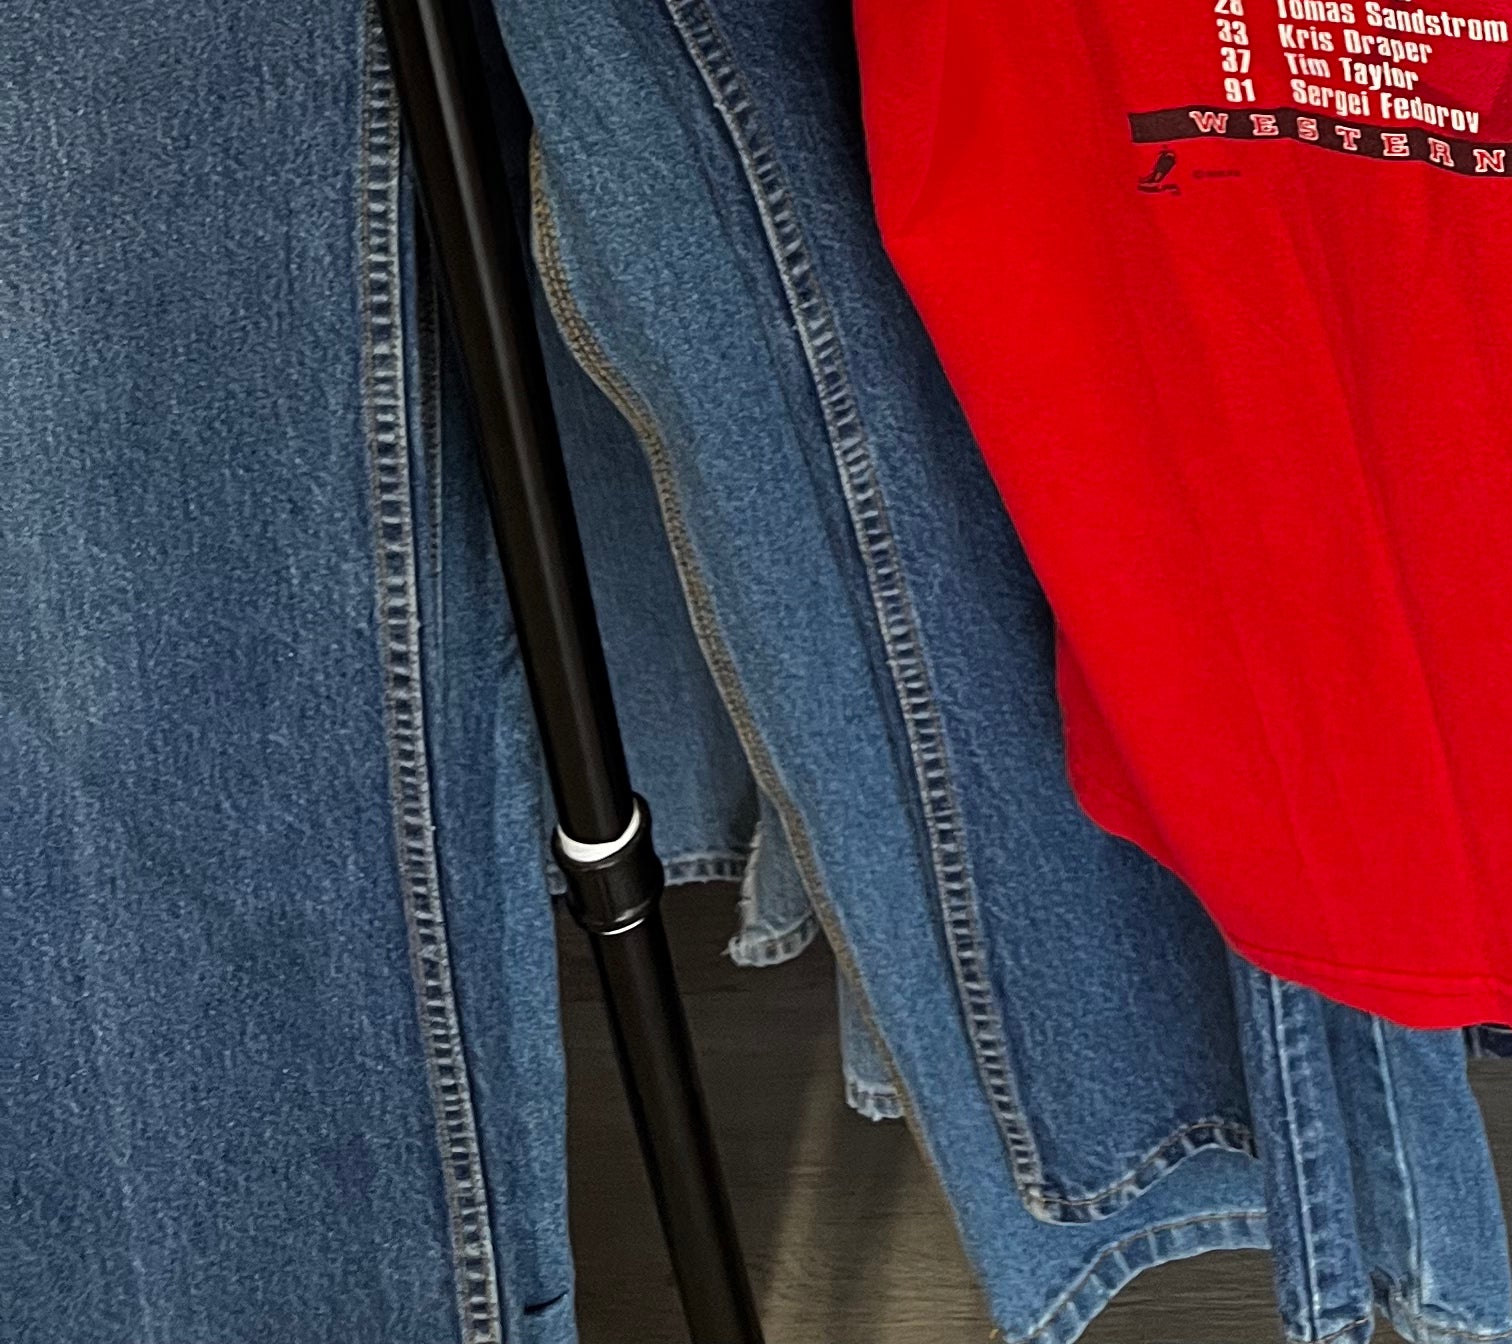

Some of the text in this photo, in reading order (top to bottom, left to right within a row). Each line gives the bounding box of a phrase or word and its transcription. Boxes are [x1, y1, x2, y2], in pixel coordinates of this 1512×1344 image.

[1216, 19, 1433, 64] 33 Kris Draper
[1365, 0, 1509, 42] Sandstrom
[1220, 47, 1419, 92] 37 Tim Taylor
[1225, 78, 1479, 133] 91 Sergei Fedorov
[1190, 110, 1506, 173] WESTERN
